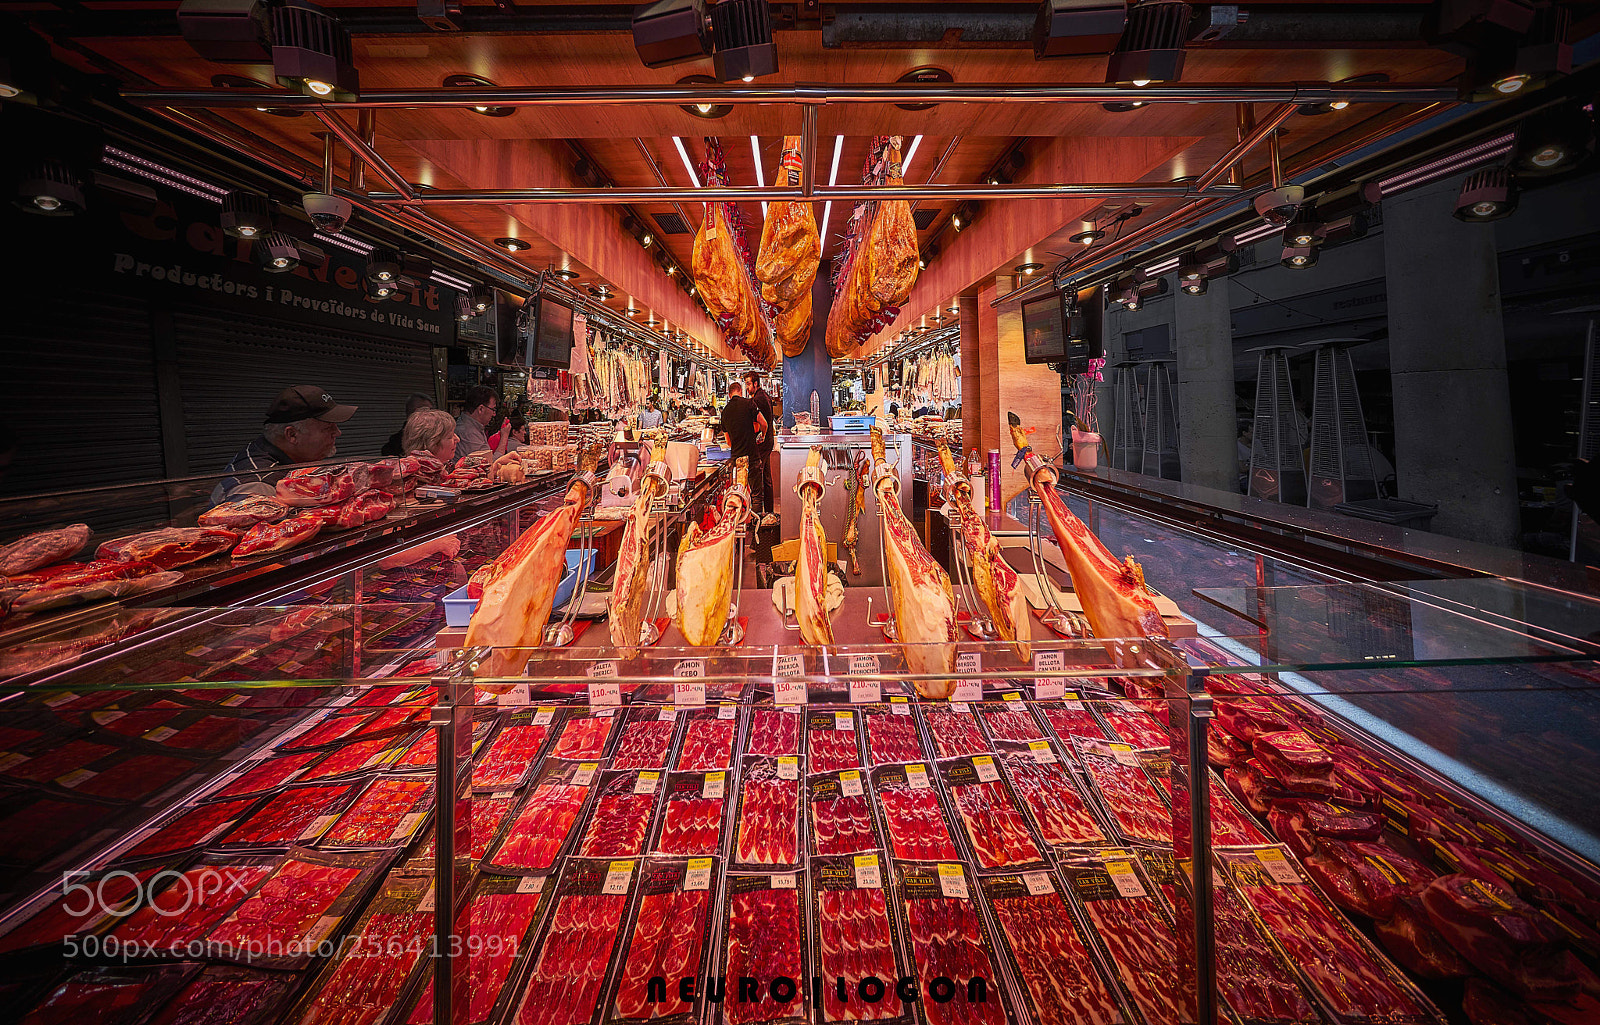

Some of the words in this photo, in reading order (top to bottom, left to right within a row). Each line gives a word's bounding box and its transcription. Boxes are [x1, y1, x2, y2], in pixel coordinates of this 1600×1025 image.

[113, 253, 259, 300] Productors
[265, 286, 275, 303] i
[279, 288, 367, 321] Proveïdors
[370, 309, 385, 324] de
[388, 313, 415, 330] Vida
[416, 318, 441, 335] Sana
